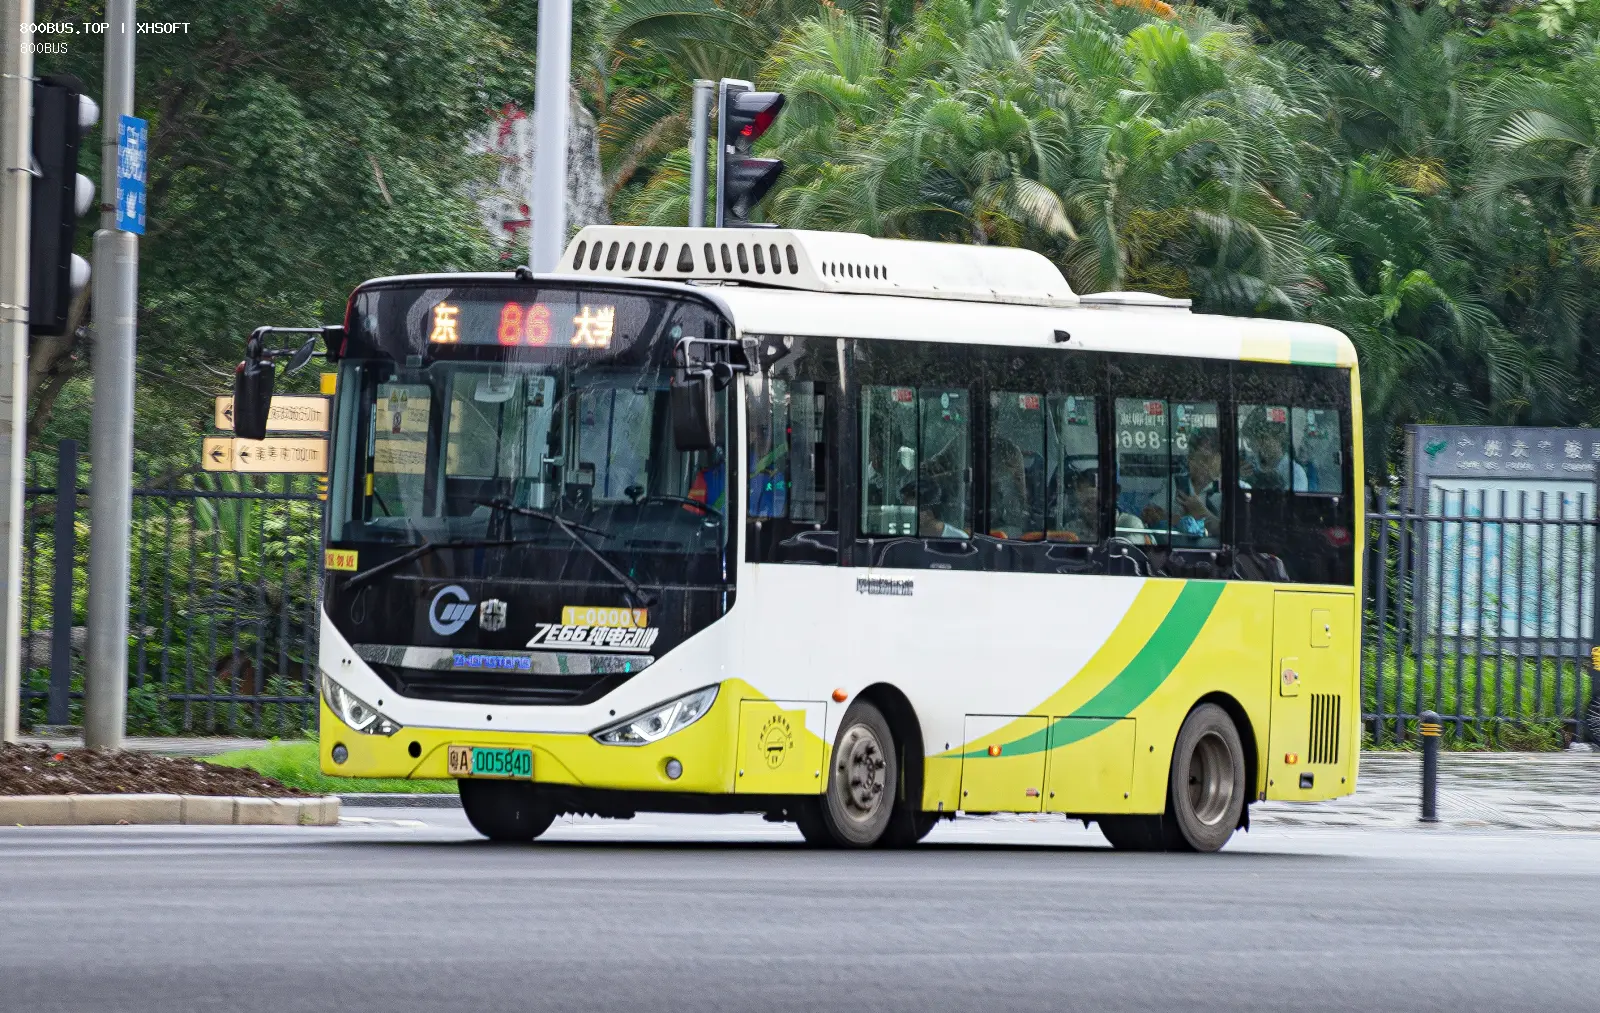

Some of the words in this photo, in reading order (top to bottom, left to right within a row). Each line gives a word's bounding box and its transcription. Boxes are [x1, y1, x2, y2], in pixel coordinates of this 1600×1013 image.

[498, 302, 551, 346] 86
[567, 607, 641, 625] 1-00007
[476, 750, 531, 774] 00584D
